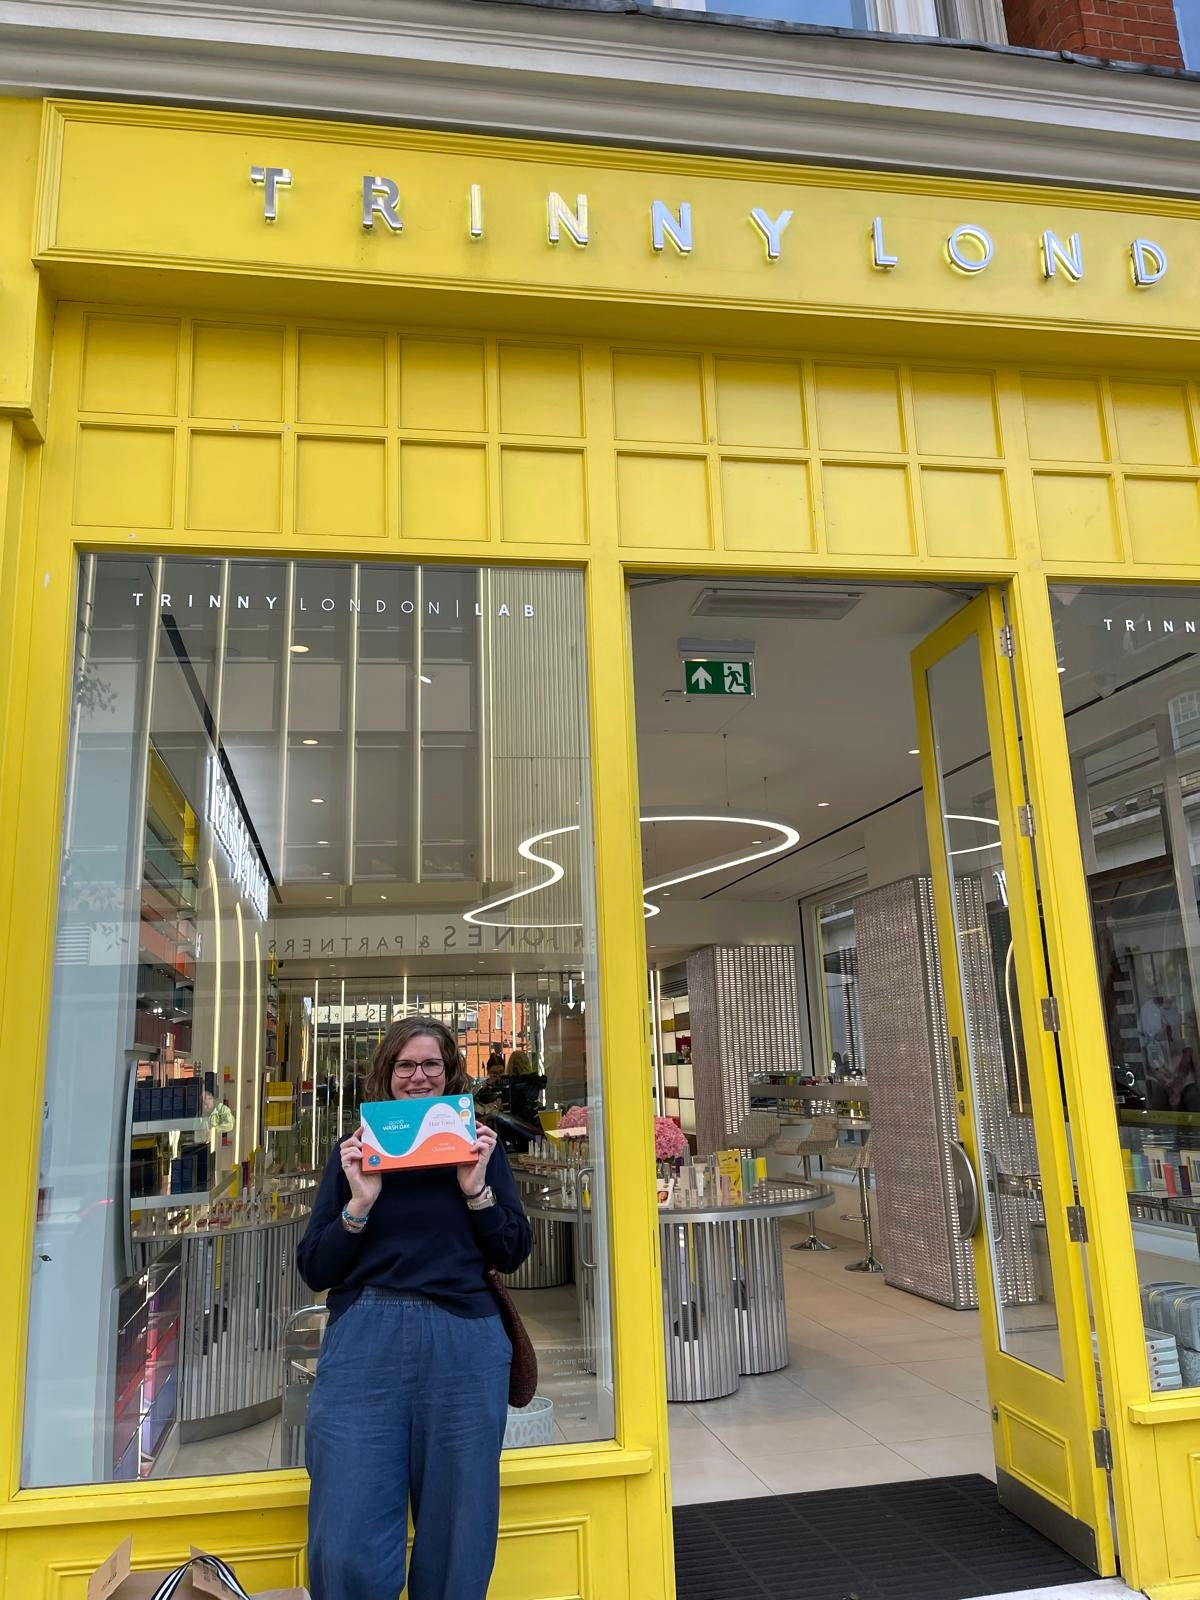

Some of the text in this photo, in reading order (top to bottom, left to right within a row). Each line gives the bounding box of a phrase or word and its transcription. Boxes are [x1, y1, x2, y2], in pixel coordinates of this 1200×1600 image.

[250, 165, 1168, 288] TRINNY LOND
[133, 592, 278, 610] TRINNY
[300, 597, 440, 615] LONDON
[475, 602, 535, 617] LAB
[1103, 618, 1196, 633] TRINN
[382, 1124, 399, 1132] WASH
